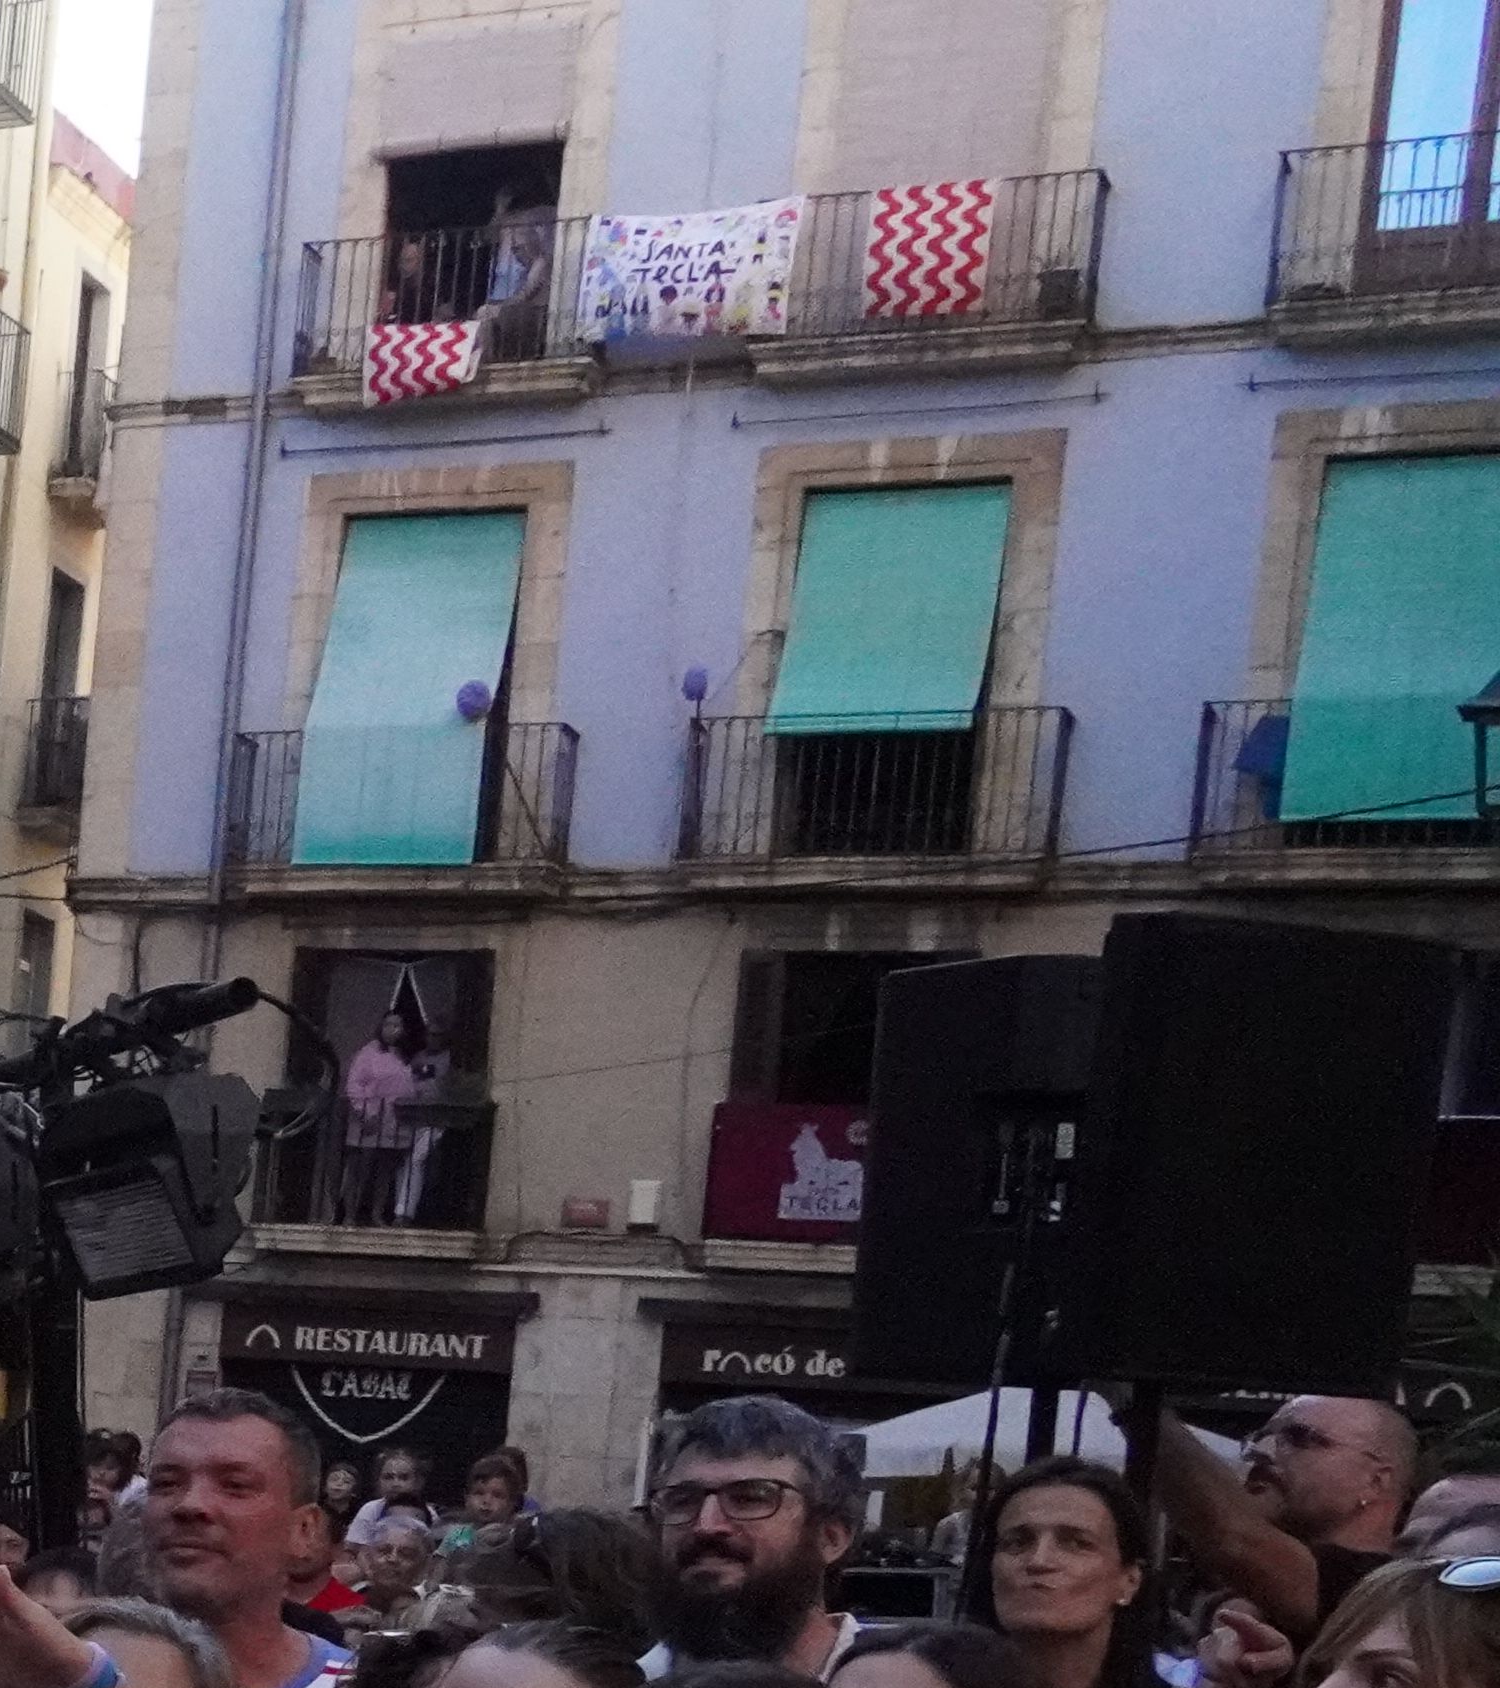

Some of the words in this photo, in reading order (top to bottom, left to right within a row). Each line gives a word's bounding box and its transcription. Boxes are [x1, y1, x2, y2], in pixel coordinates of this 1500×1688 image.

[641, 239, 727, 264] SANTA
[295, 1325, 491, 1359] RESTAURANT
[805, 1350, 846, 1378] de
